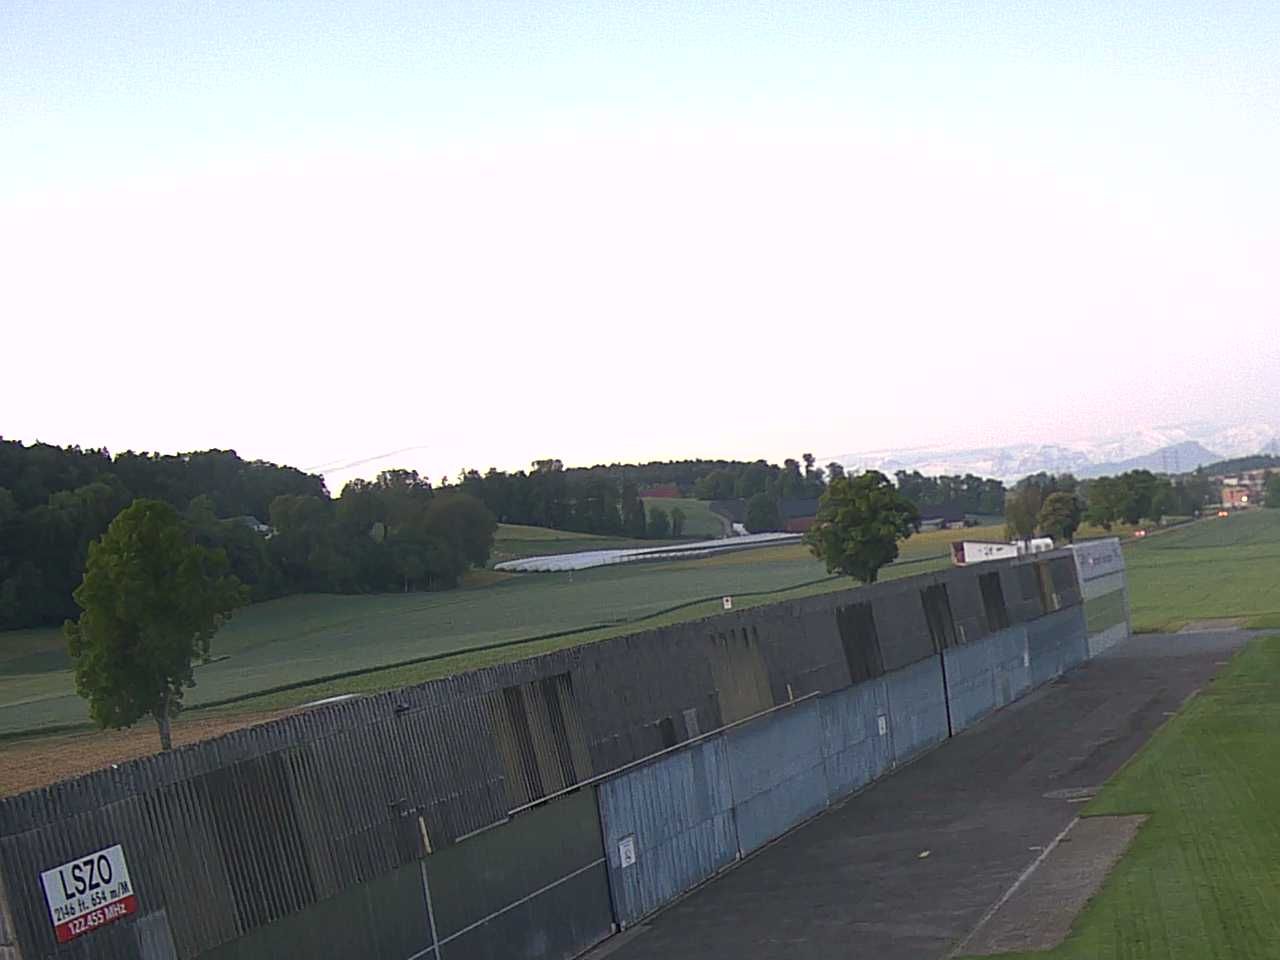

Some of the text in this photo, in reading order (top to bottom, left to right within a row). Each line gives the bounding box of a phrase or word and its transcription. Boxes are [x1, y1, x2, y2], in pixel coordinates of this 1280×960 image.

[59, 854, 112, 900] LSZO
[54, 902, 76, 921] 2146
[91, 890, 108, 906] 654
[104, 901, 128, 921] MHz
